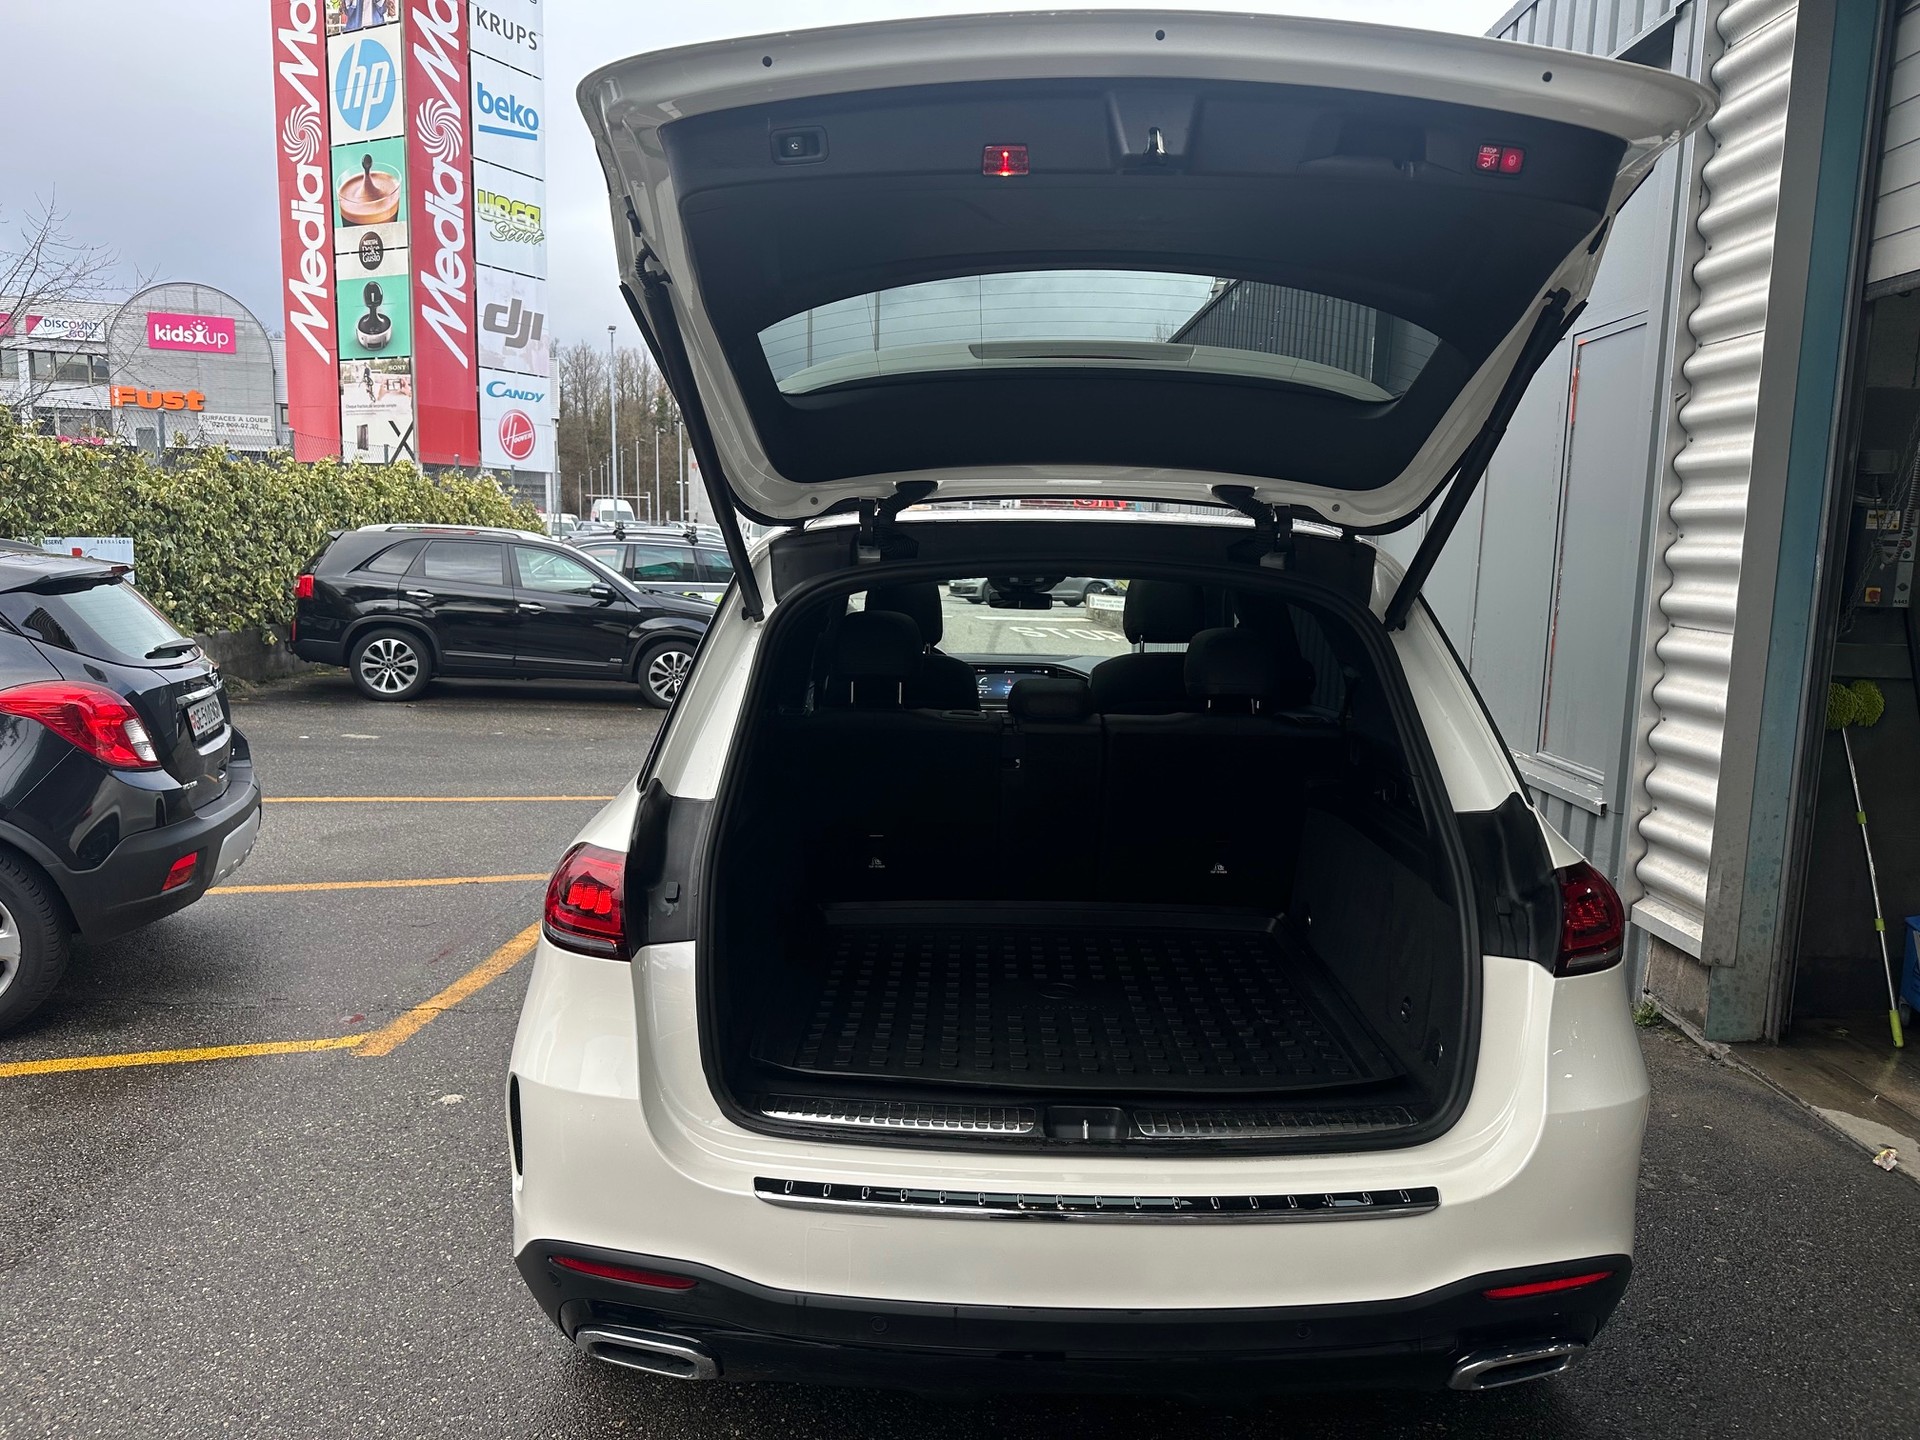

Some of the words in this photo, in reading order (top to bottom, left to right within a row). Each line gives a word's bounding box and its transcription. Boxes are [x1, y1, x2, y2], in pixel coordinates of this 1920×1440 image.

[476, 6, 537, 50] KRUPS
[342, 40, 391, 132] hp
[476, 82, 539, 131] beko
[289, 162, 331, 365] Media
[420, 157, 469, 370] Media
[44, 319, 99, 330] DISCOUNT
[154, 323, 194, 343] kids
